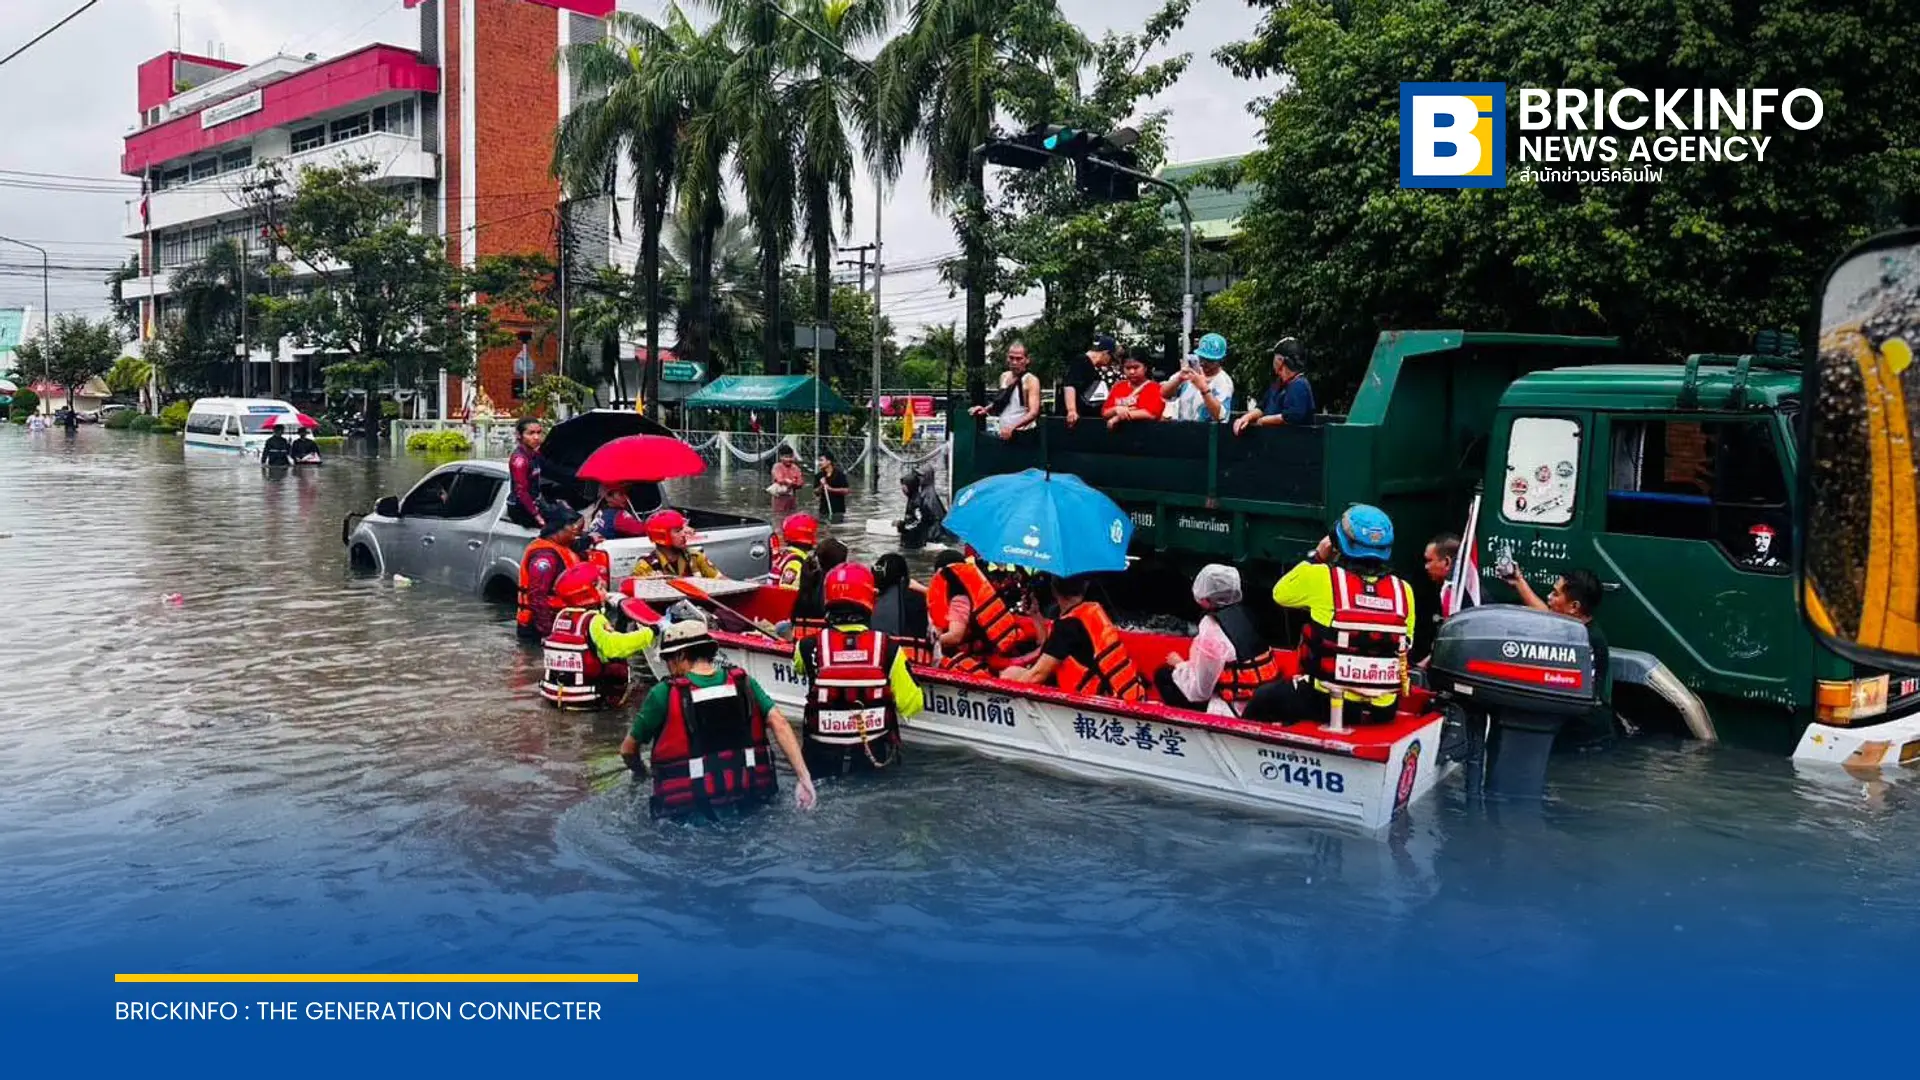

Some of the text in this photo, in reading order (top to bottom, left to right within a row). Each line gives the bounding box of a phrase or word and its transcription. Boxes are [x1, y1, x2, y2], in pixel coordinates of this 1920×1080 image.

[1521, 643, 1577, 663] YAMAHA
[1072, 712, 1188, 758] 報德善堂
[1278, 762, 1345, 794] 1418
